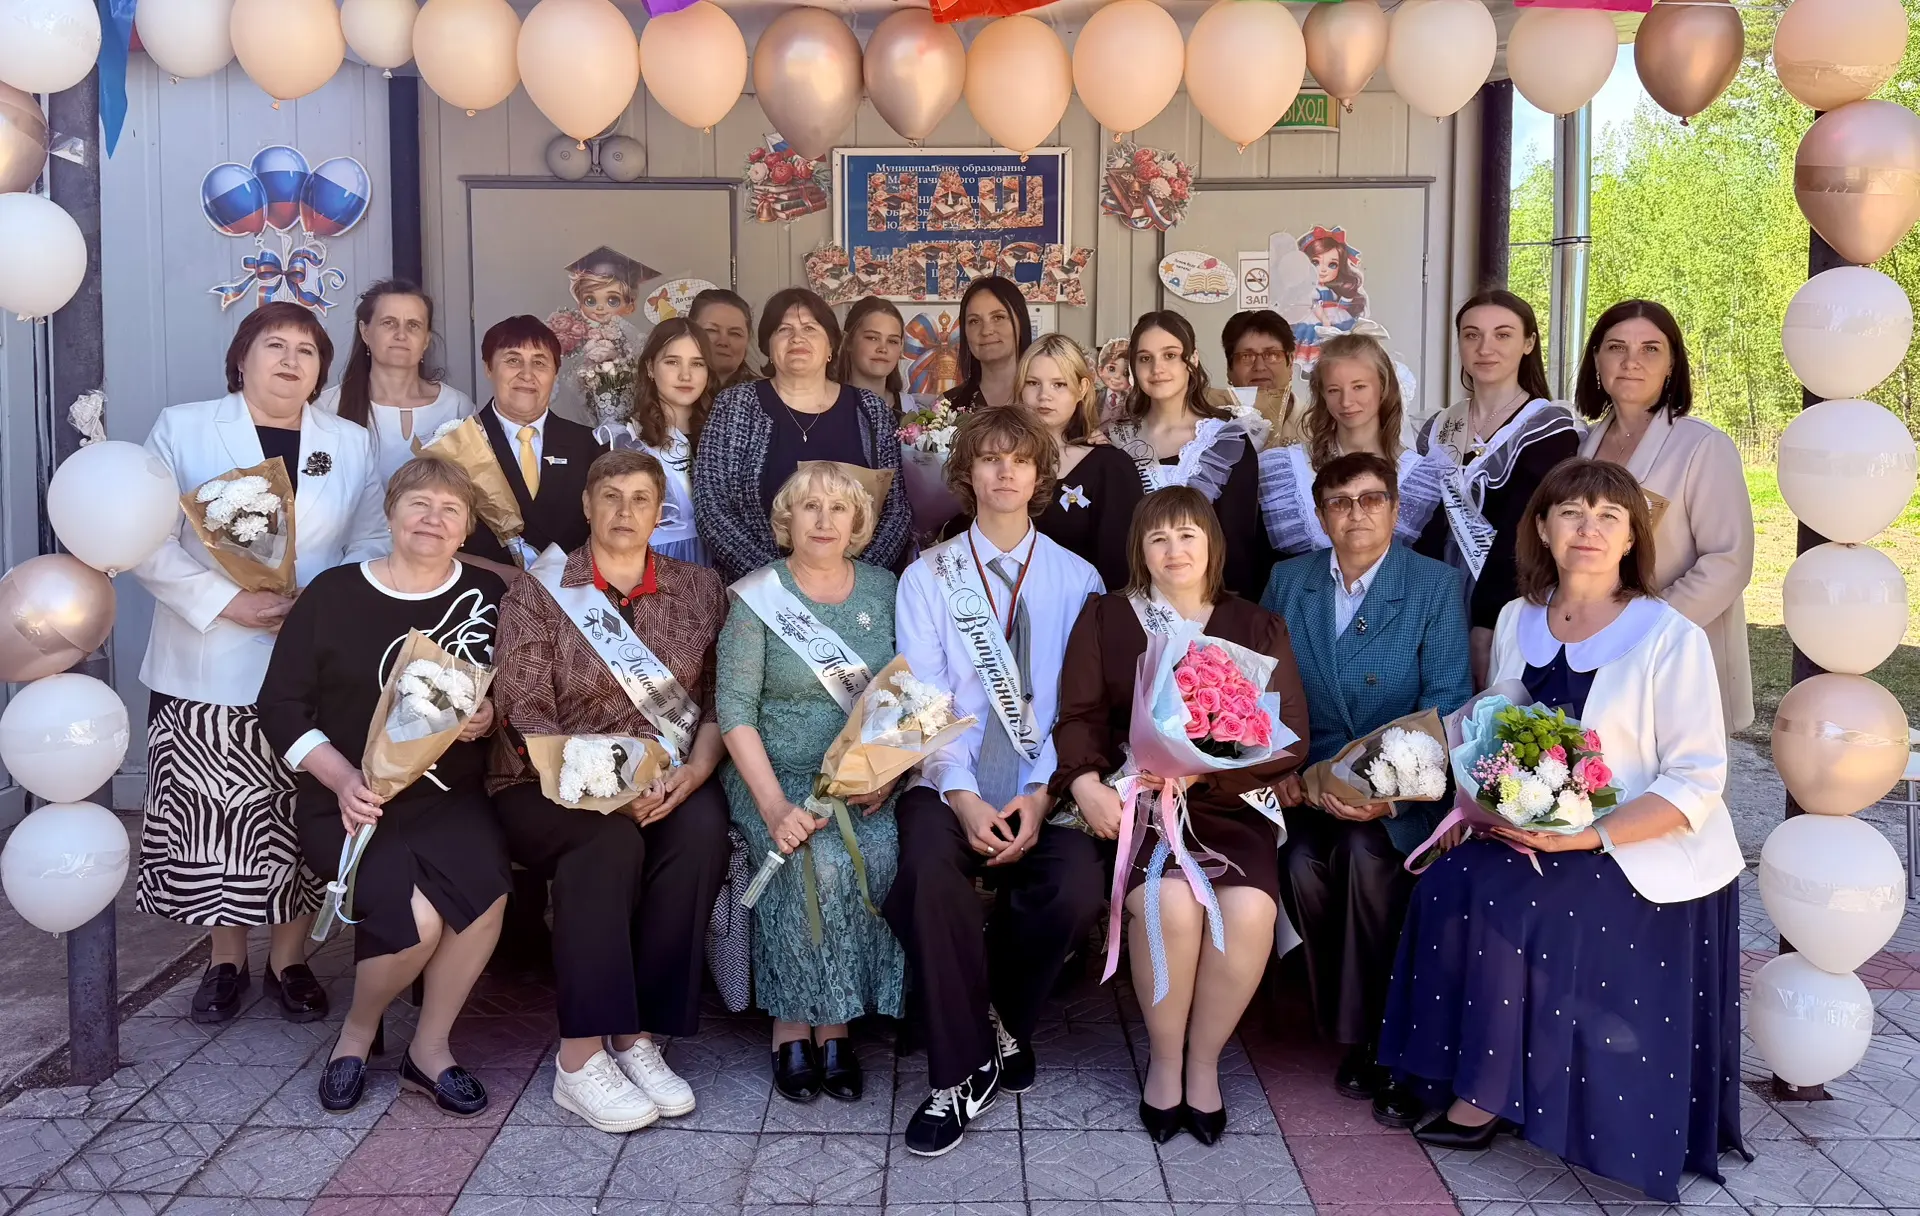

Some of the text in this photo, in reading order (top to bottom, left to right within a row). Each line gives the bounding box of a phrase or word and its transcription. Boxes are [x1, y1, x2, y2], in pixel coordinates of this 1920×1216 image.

[1282, 98, 1325, 124] ЫХОД
[876, 163, 1027, 174] Муниципальное образование
[867, 166, 1044, 232] НАШ
[802, 242, 1096, 308] ВЫПУСК
[807, 637, 855, 695] Первый
[949, 587, 1022, 733] Выпускник
[1007, 675, 1020, 698] Данил
